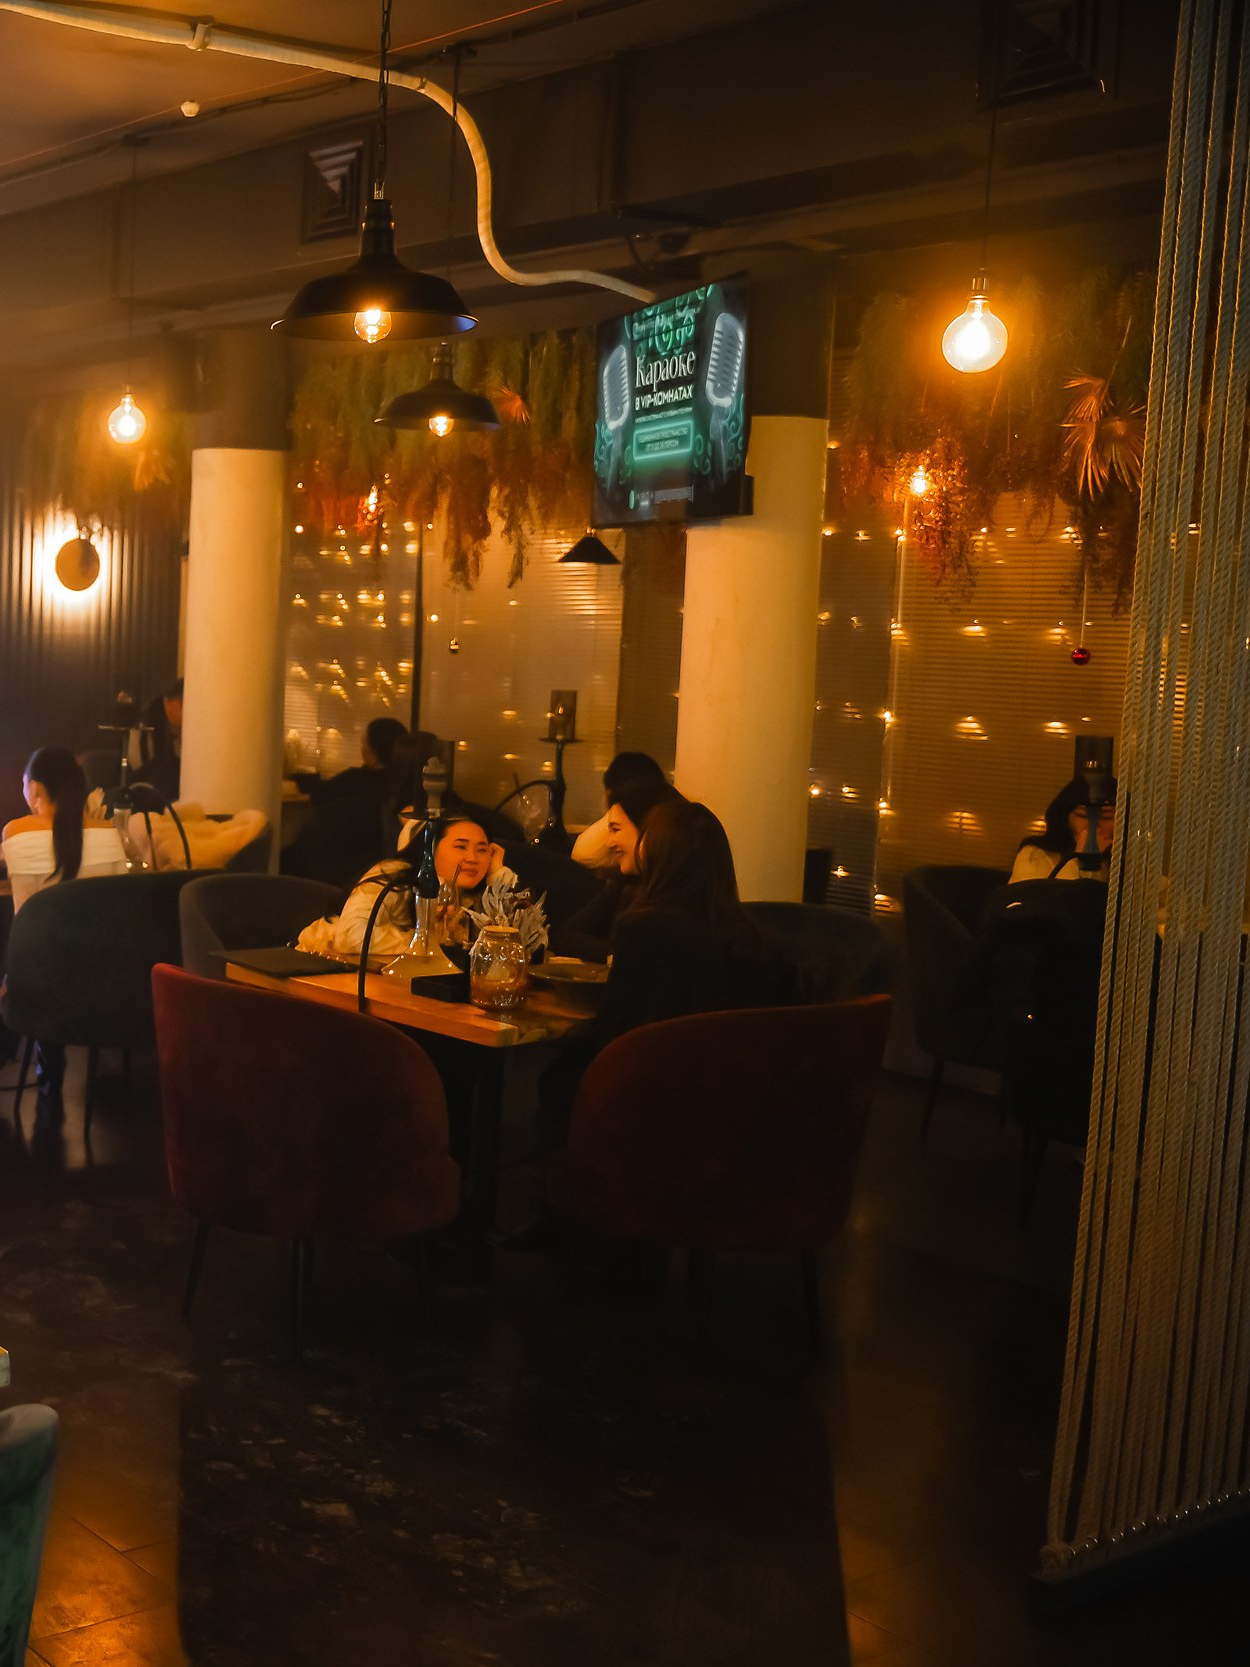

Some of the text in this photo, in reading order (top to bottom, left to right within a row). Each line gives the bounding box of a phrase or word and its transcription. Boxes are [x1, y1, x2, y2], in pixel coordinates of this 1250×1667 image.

[635, 351, 696, 392] Караоке
[635, 384, 693, 411] В VIP-КОМНАТАХ
